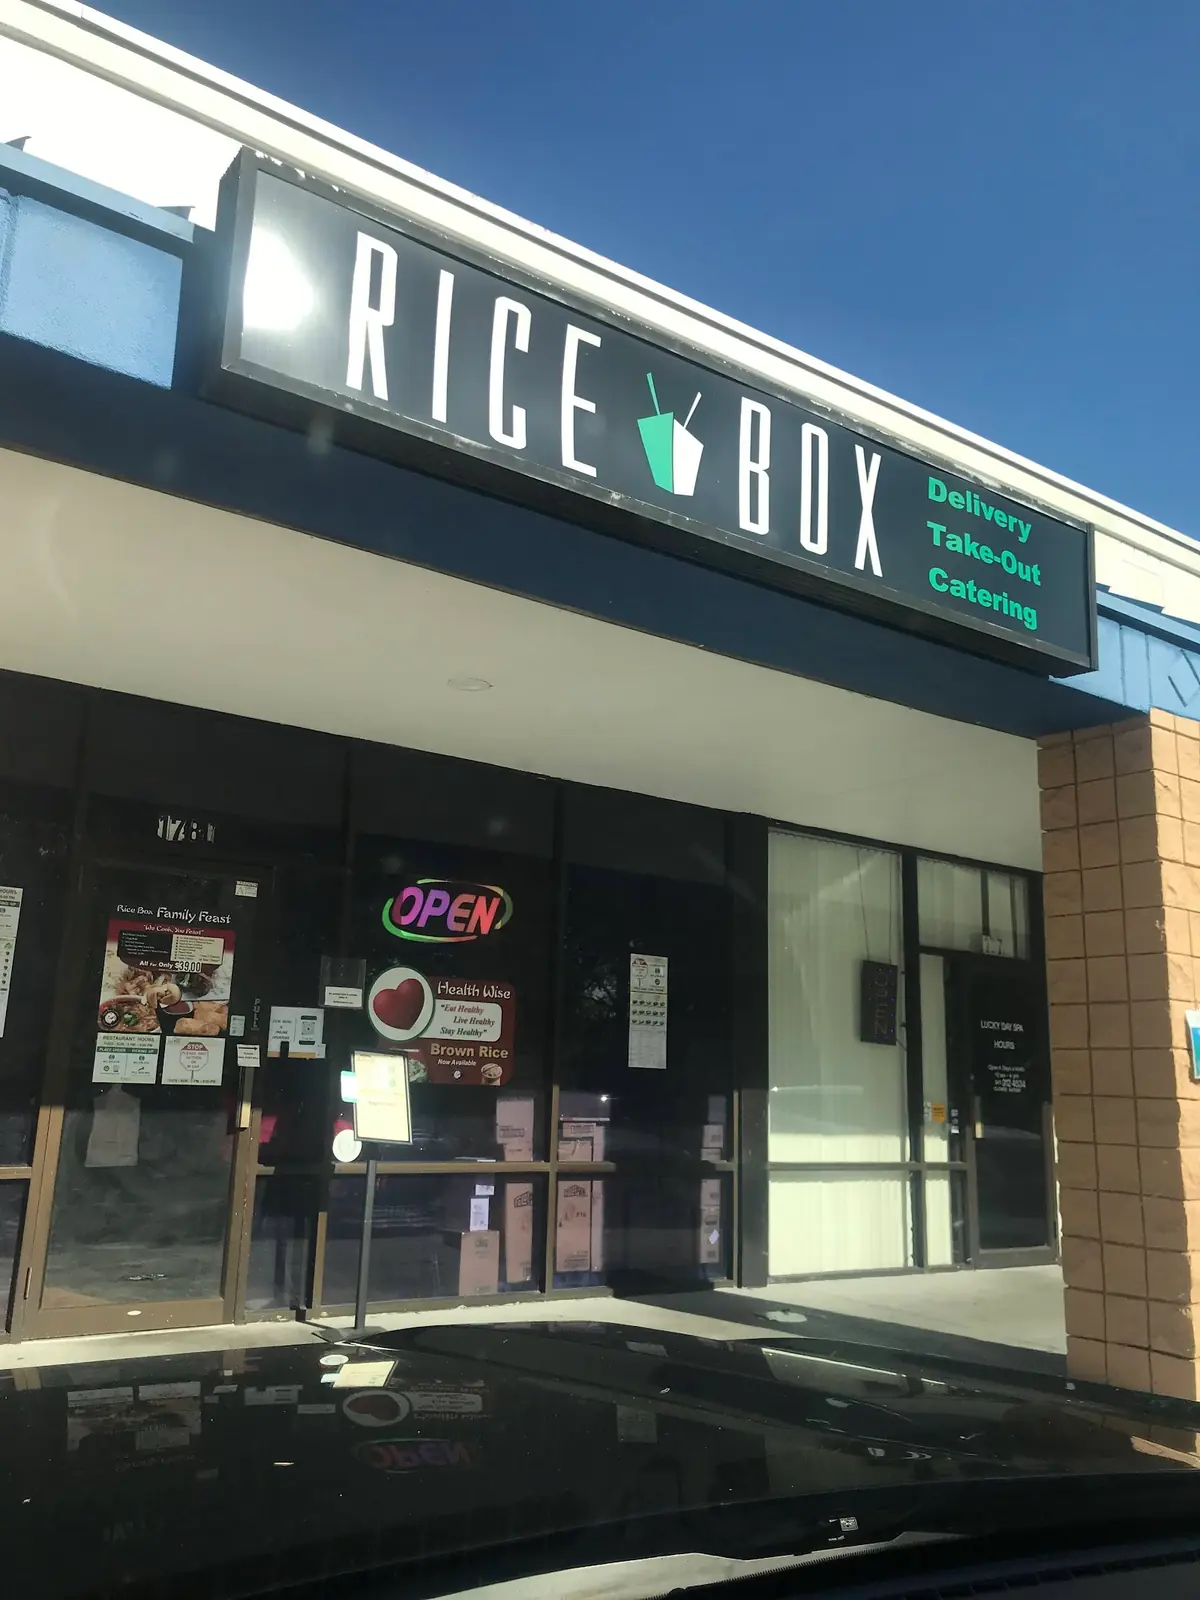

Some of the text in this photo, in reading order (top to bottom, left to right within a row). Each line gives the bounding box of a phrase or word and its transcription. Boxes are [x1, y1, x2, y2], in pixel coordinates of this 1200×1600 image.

[346, 231, 882, 577] RICE BOX
[927, 476, 1032, 543] Delivery
[926, 521, 1041, 587] Take-Out
[928, 568, 1038, 631] Catering
[116, 904, 232, 924] Rice Box Family Feast
[391, 886, 501, 935] OPEN
[139, 960, 149, 968] All
[158, 961, 174, 969] Only
[437, 980, 512, 999] Health Wise
[457, 1004, 484, 1016] Healthy
[453, 1015, 495, 1027] Live Healthy
[980, 1019, 1000, 1030] LUCKY
[1012, 1022, 1024, 1033] SPA
[440, 1026, 455, 1036] Stay
[430, 1042, 509, 1059] Brown Rice
[993, 1039, 1015, 1050] HOURS
[437, 1058, 477, 1067] Now Available
